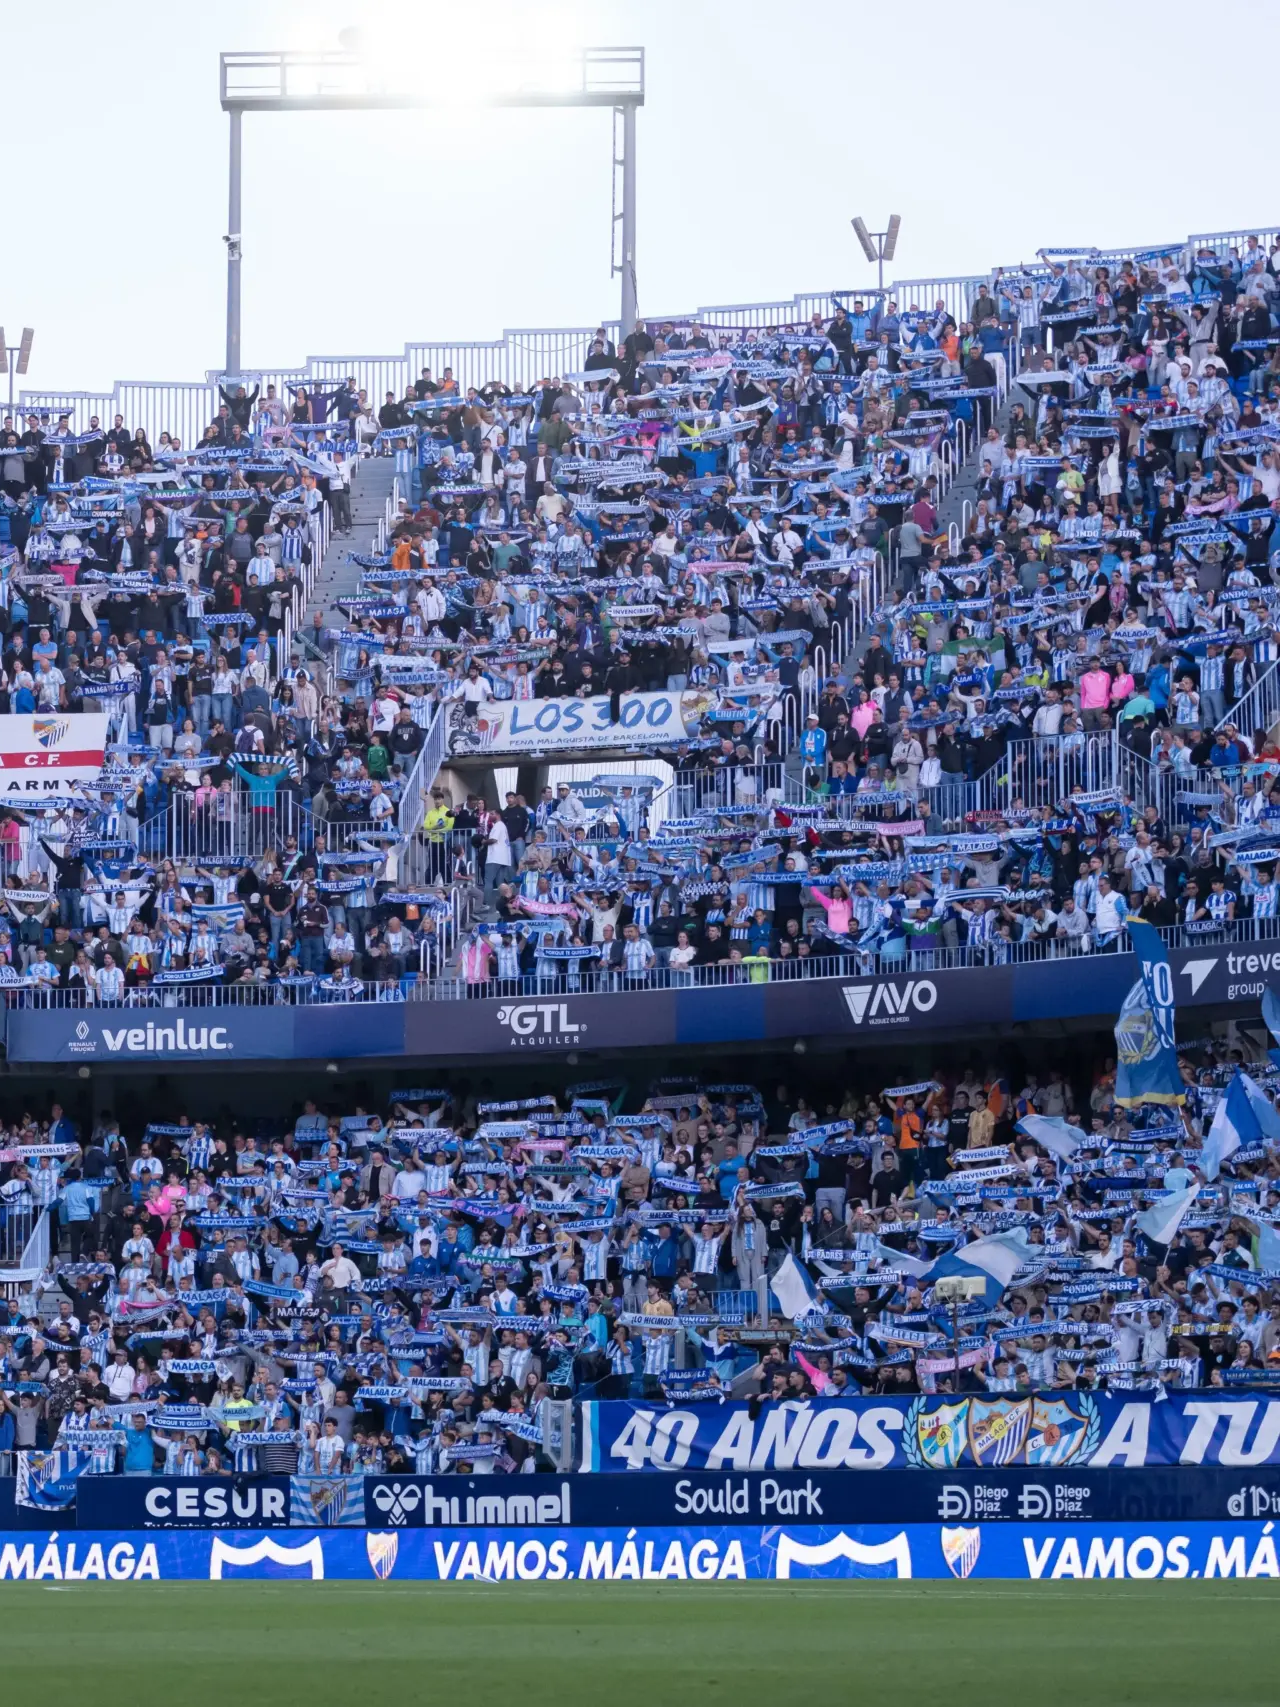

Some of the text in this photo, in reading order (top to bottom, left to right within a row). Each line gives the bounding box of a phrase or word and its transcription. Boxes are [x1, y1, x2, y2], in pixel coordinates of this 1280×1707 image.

[612, 607, 654, 615] INVENCIBLES
[510, 702, 584, 735] LOS
[537, 735, 594, 744] MALAGUISTA
[613, 732, 669, 742] BARCELONA
[24, 753, 61, 765] C.F.
[7, 780, 80, 790] ARMY
[1228, 981, 1264, 999] group
[509, 1004, 580, 1036] GTL
[101, 1019, 227, 1050] veinluc
[510, 1038, 580, 1046] ALQUILER
[19, 1144, 65, 1154] INVENCIBLES
[580, 1147, 624, 1156] MALAGA
[961, 1150, 1004, 1160] INVENCIBLES
[961, 1167, 1010, 1180] INVENCIBLES
[172, 1361, 215, 1372] MALAGA
[612, 1400, 1280, 1472] 40 AÑOS A TU
[675, 1480, 823, 1515] Sould Park
[975, 1485, 1009, 1499] Diego
[1056, 1485, 1090, 1499] Diego
[145, 1487, 285, 1518] CESUR
[425, 1482, 572, 1522] hummel
[975, 1498, 1000, 1512] Díaz
[1056, 1498, 1082, 1512] Díaz
[434, 1528, 746, 1580] VAMOS, MÁLAGA
[1023, 1536, 1199, 1578] VAMOS,
